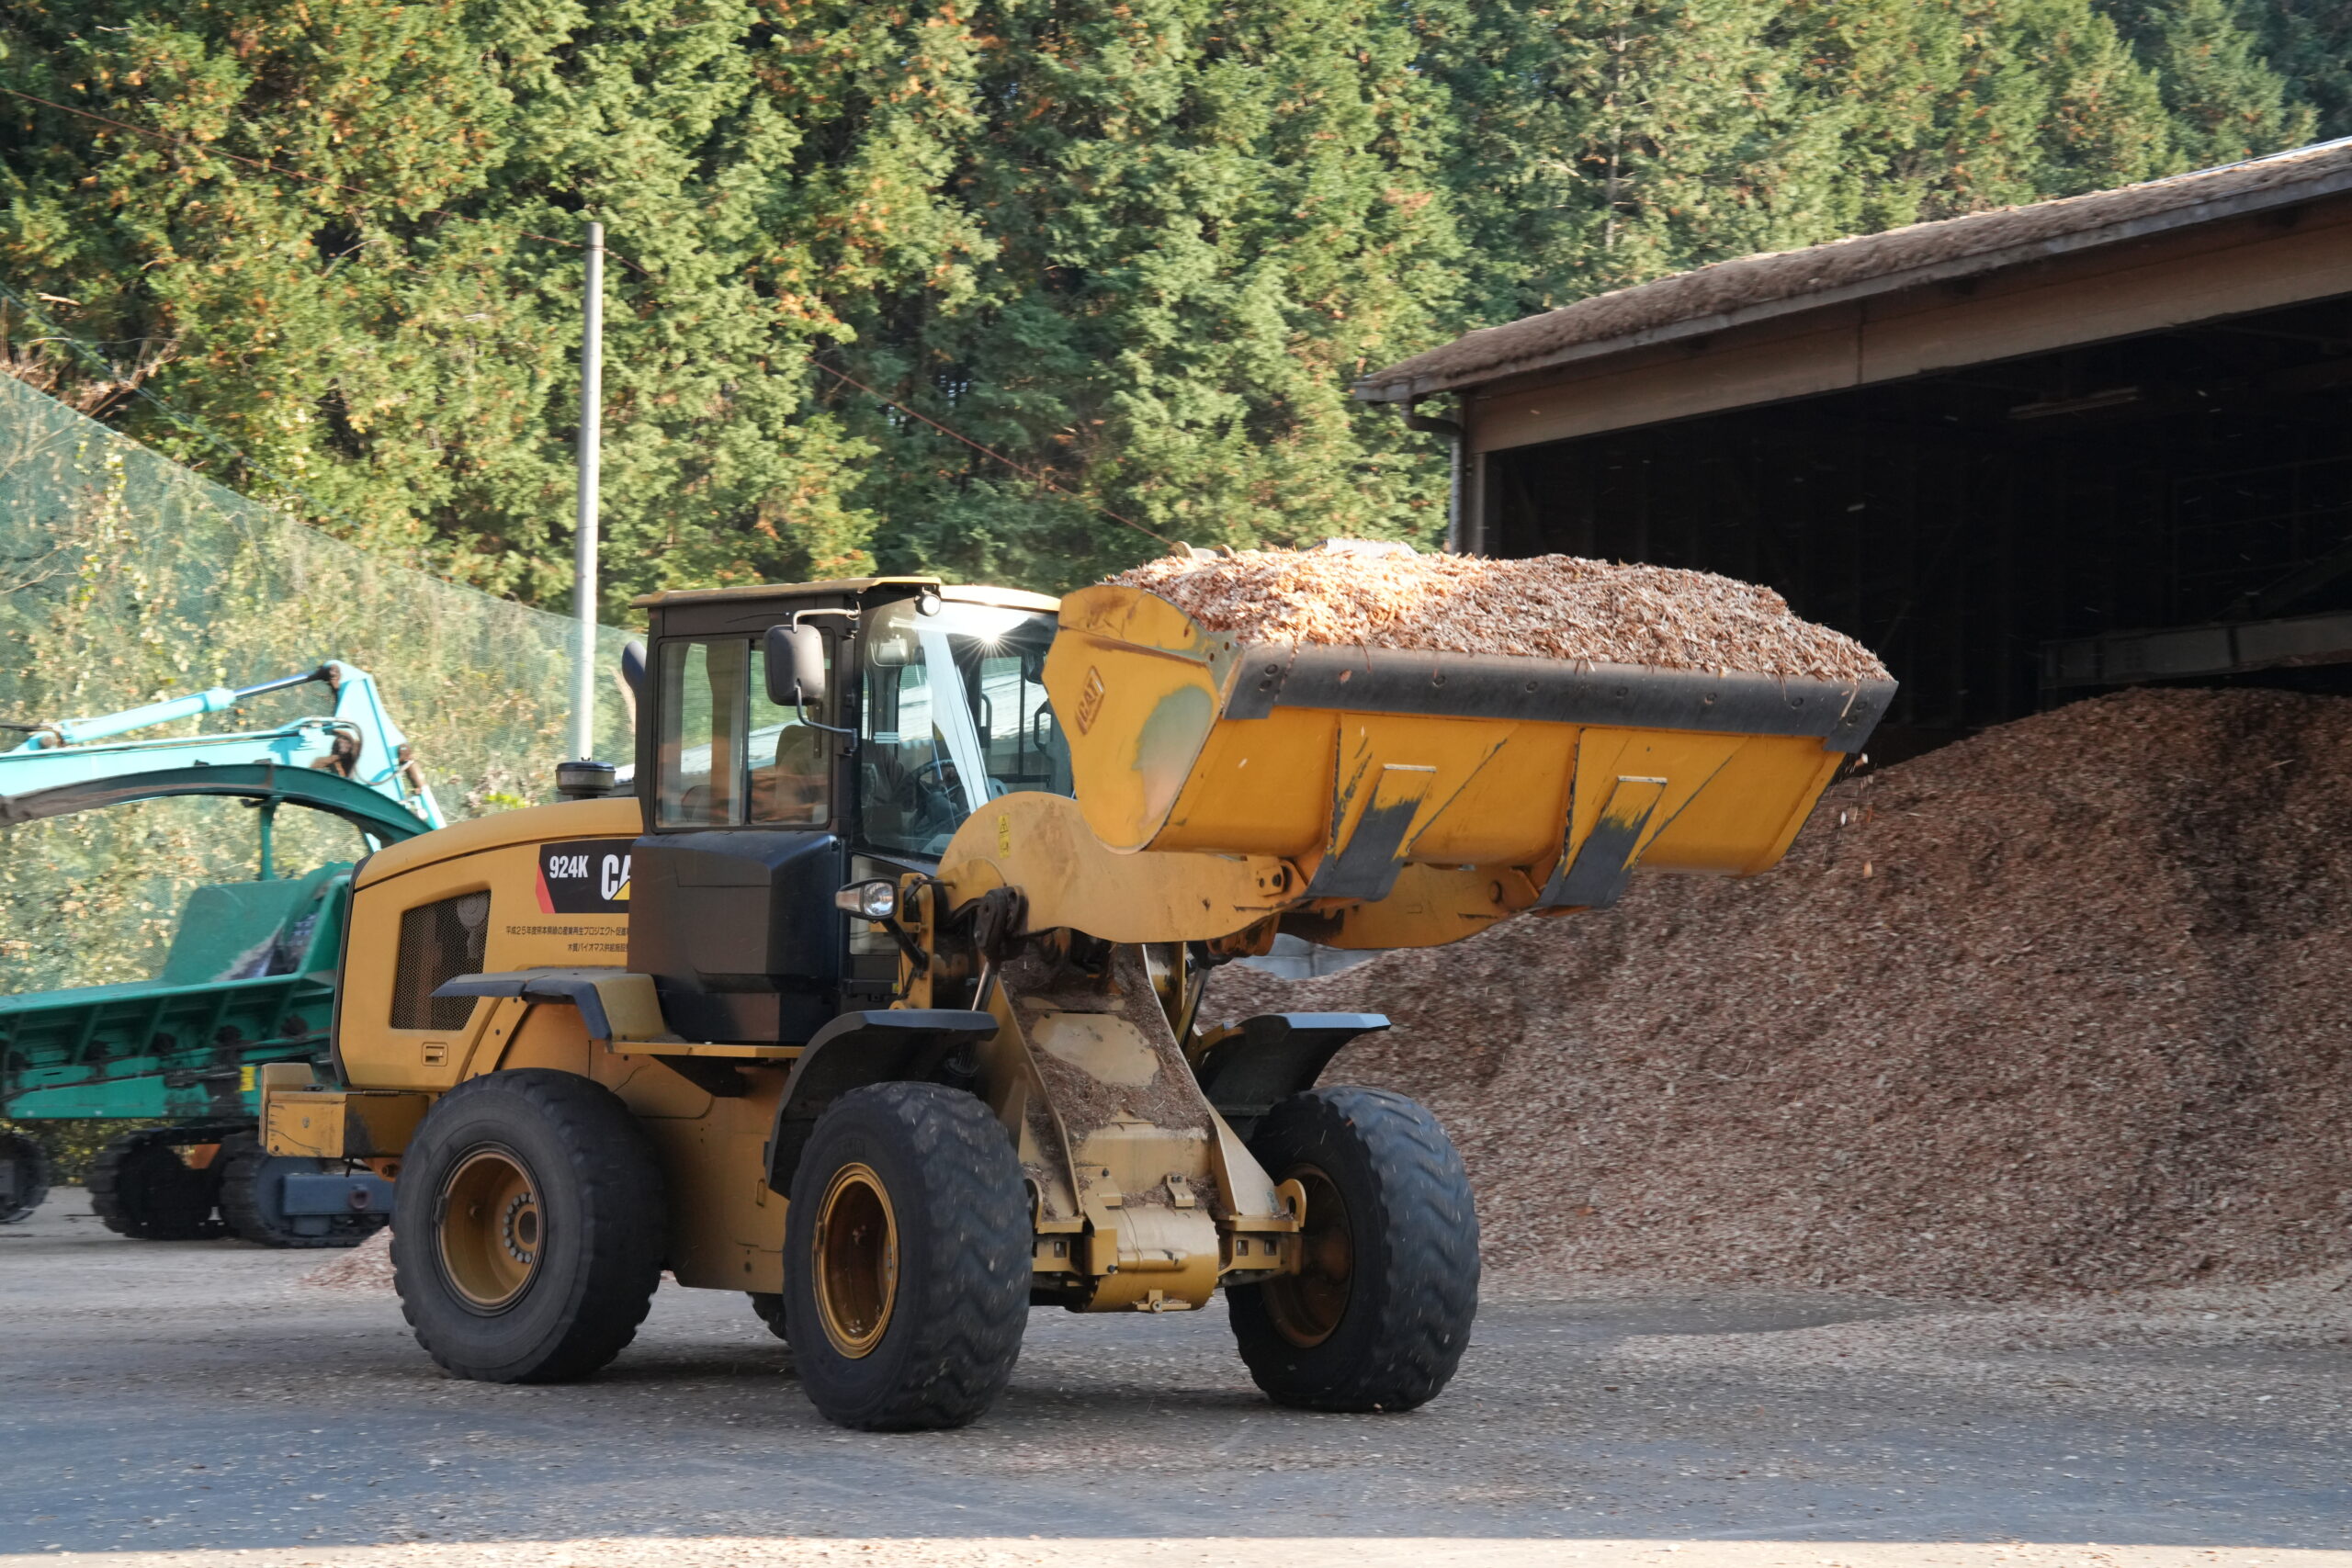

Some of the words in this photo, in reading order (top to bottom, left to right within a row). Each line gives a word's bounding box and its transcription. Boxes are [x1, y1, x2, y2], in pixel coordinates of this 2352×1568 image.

[1076, 673, 1100, 725] CAT
[549, 855, 589, 878] 924K
[567, 942, 628, 953] 木質バイオマス供給施設
